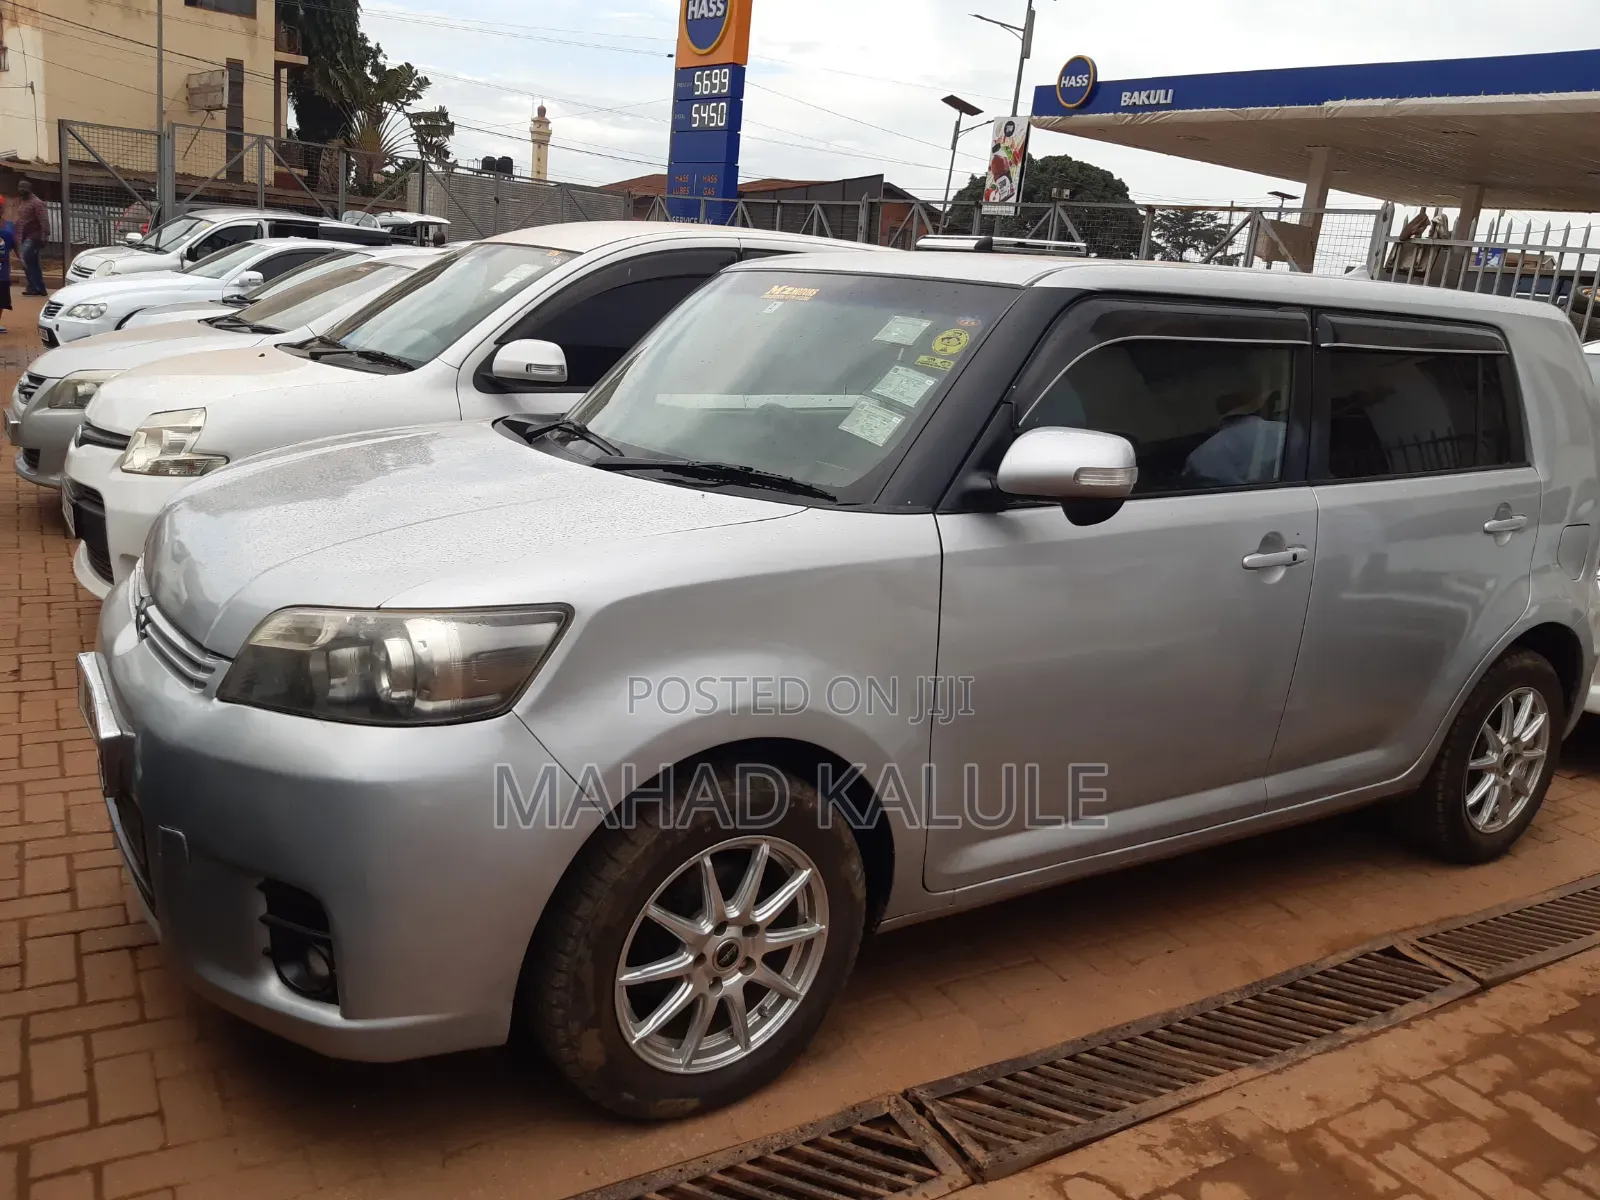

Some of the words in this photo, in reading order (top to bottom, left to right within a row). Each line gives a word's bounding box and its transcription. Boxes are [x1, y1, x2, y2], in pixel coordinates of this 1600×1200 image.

[687, 0, 726, 20] HASS
[694, 68, 729, 95] 5699
[1060, 74, 1089, 88] HASS
[1120, 89, 1174, 106] BAKULI
[691, 102, 727, 127] 5450
[702, 174, 718, 184] HASS
[672, 186, 690, 195] LUBES
[702, 187, 716, 196] GAS
